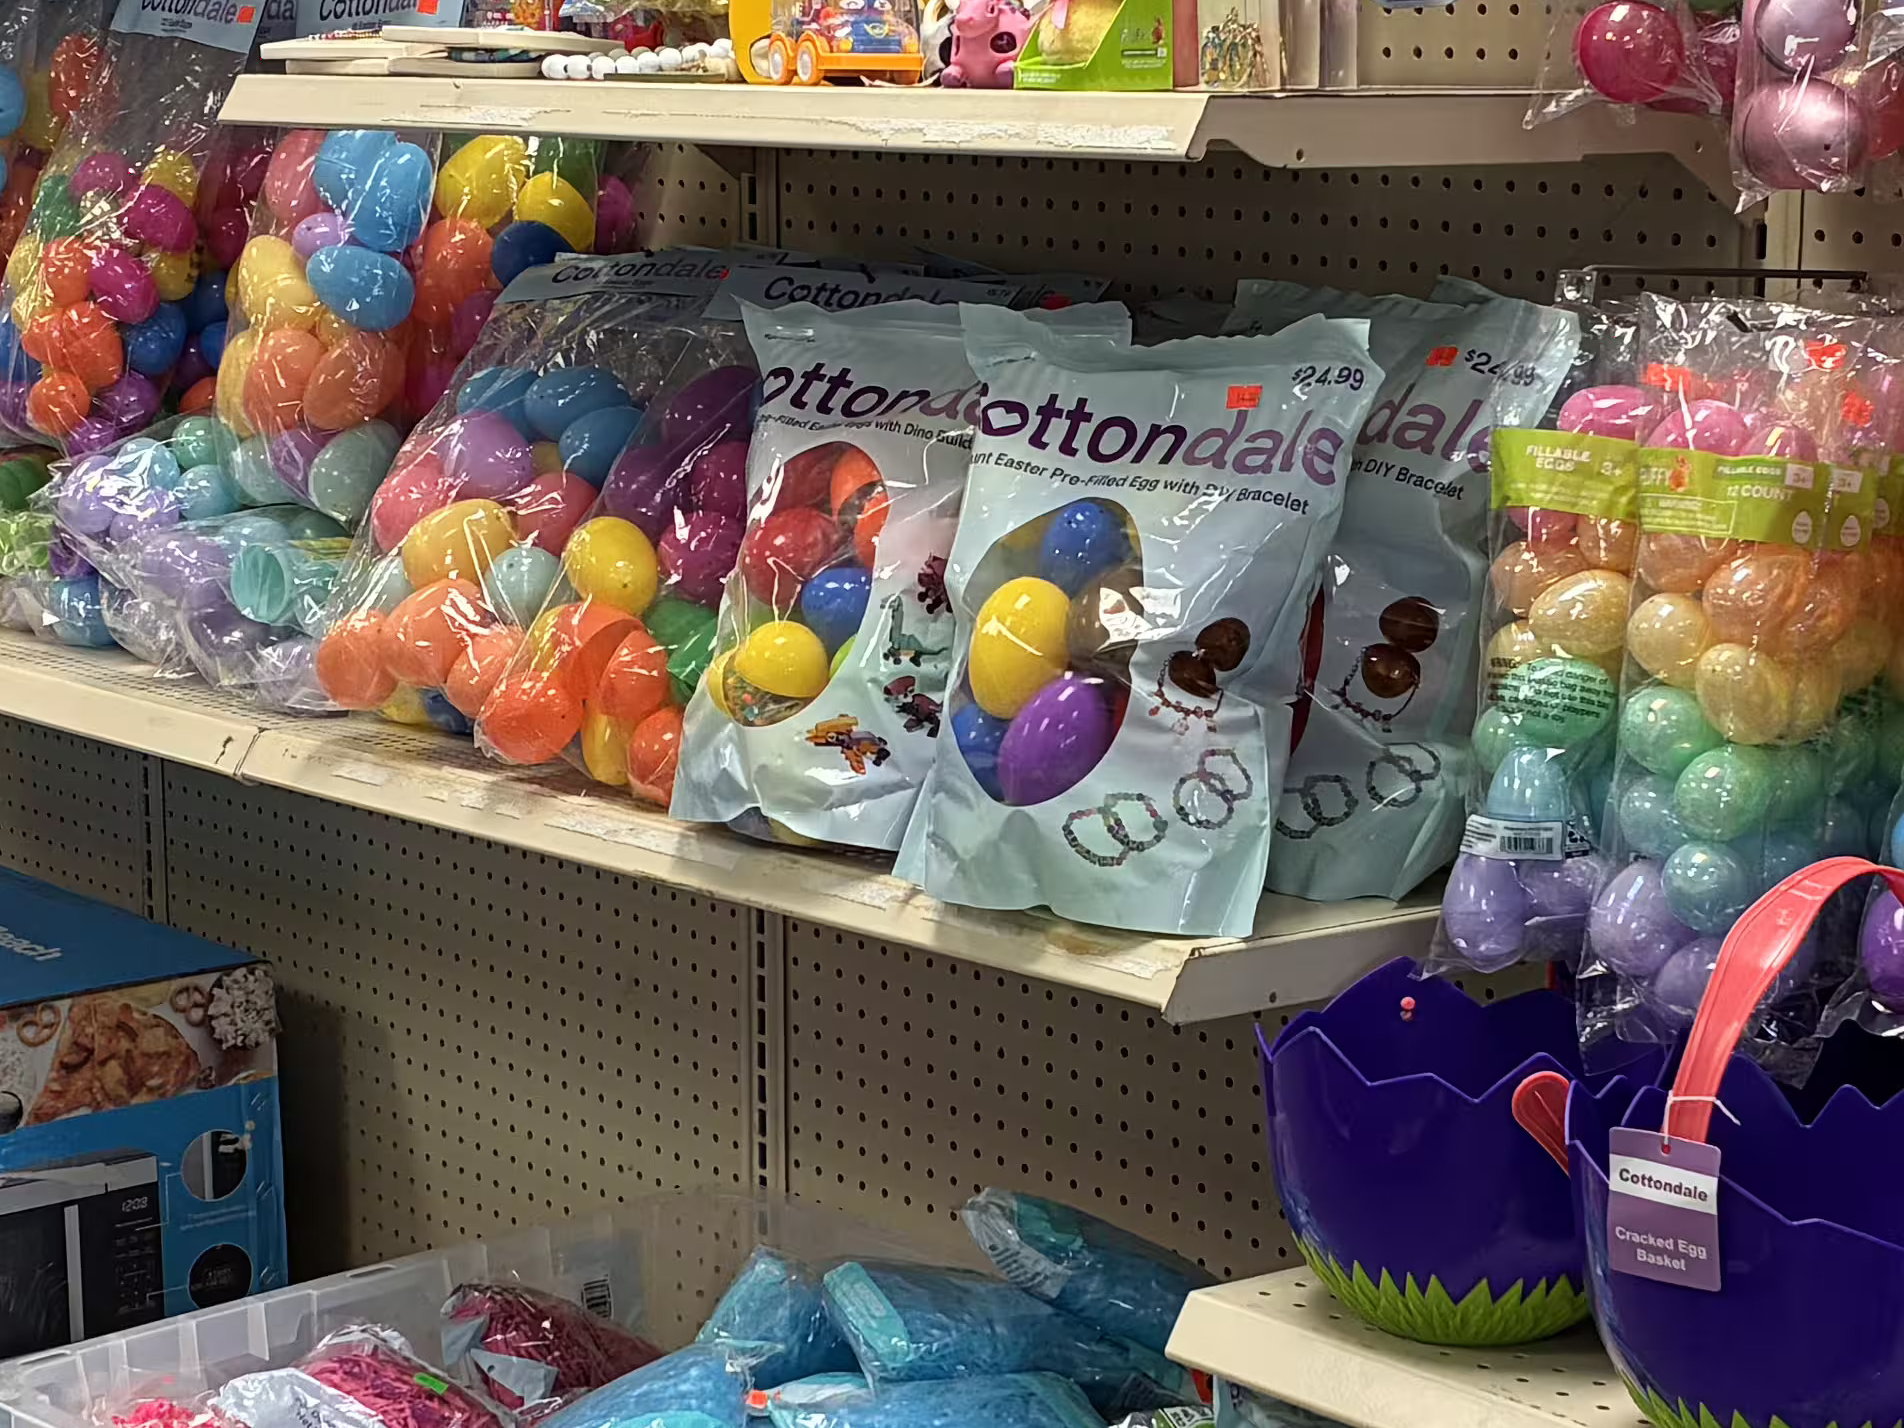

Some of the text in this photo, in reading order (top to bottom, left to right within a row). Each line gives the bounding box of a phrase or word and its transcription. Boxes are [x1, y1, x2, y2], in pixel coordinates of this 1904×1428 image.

[1292, 365, 1364, 390] $24.99
[875, 421, 901, 433] with
[904, 423, 933, 440] Dino
[979, 383, 1345, 486] ottondale
[1526, 444, 1591, 461] FILLABLE
[1536, 458, 1576, 472] EGGS
[993, 453, 1309, 515] Easter Pre-Filled Egg with Bracelet
[1365, 459, 1465, 501] DIY Bracelet
[1740, 485, 1792, 501] COUNT
[1619, 1169, 1707, 1202] Cottondale
[1615, 1227, 1707, 1260] Cracked Egg
[1636, 1249, 1687, 1272] Basket
